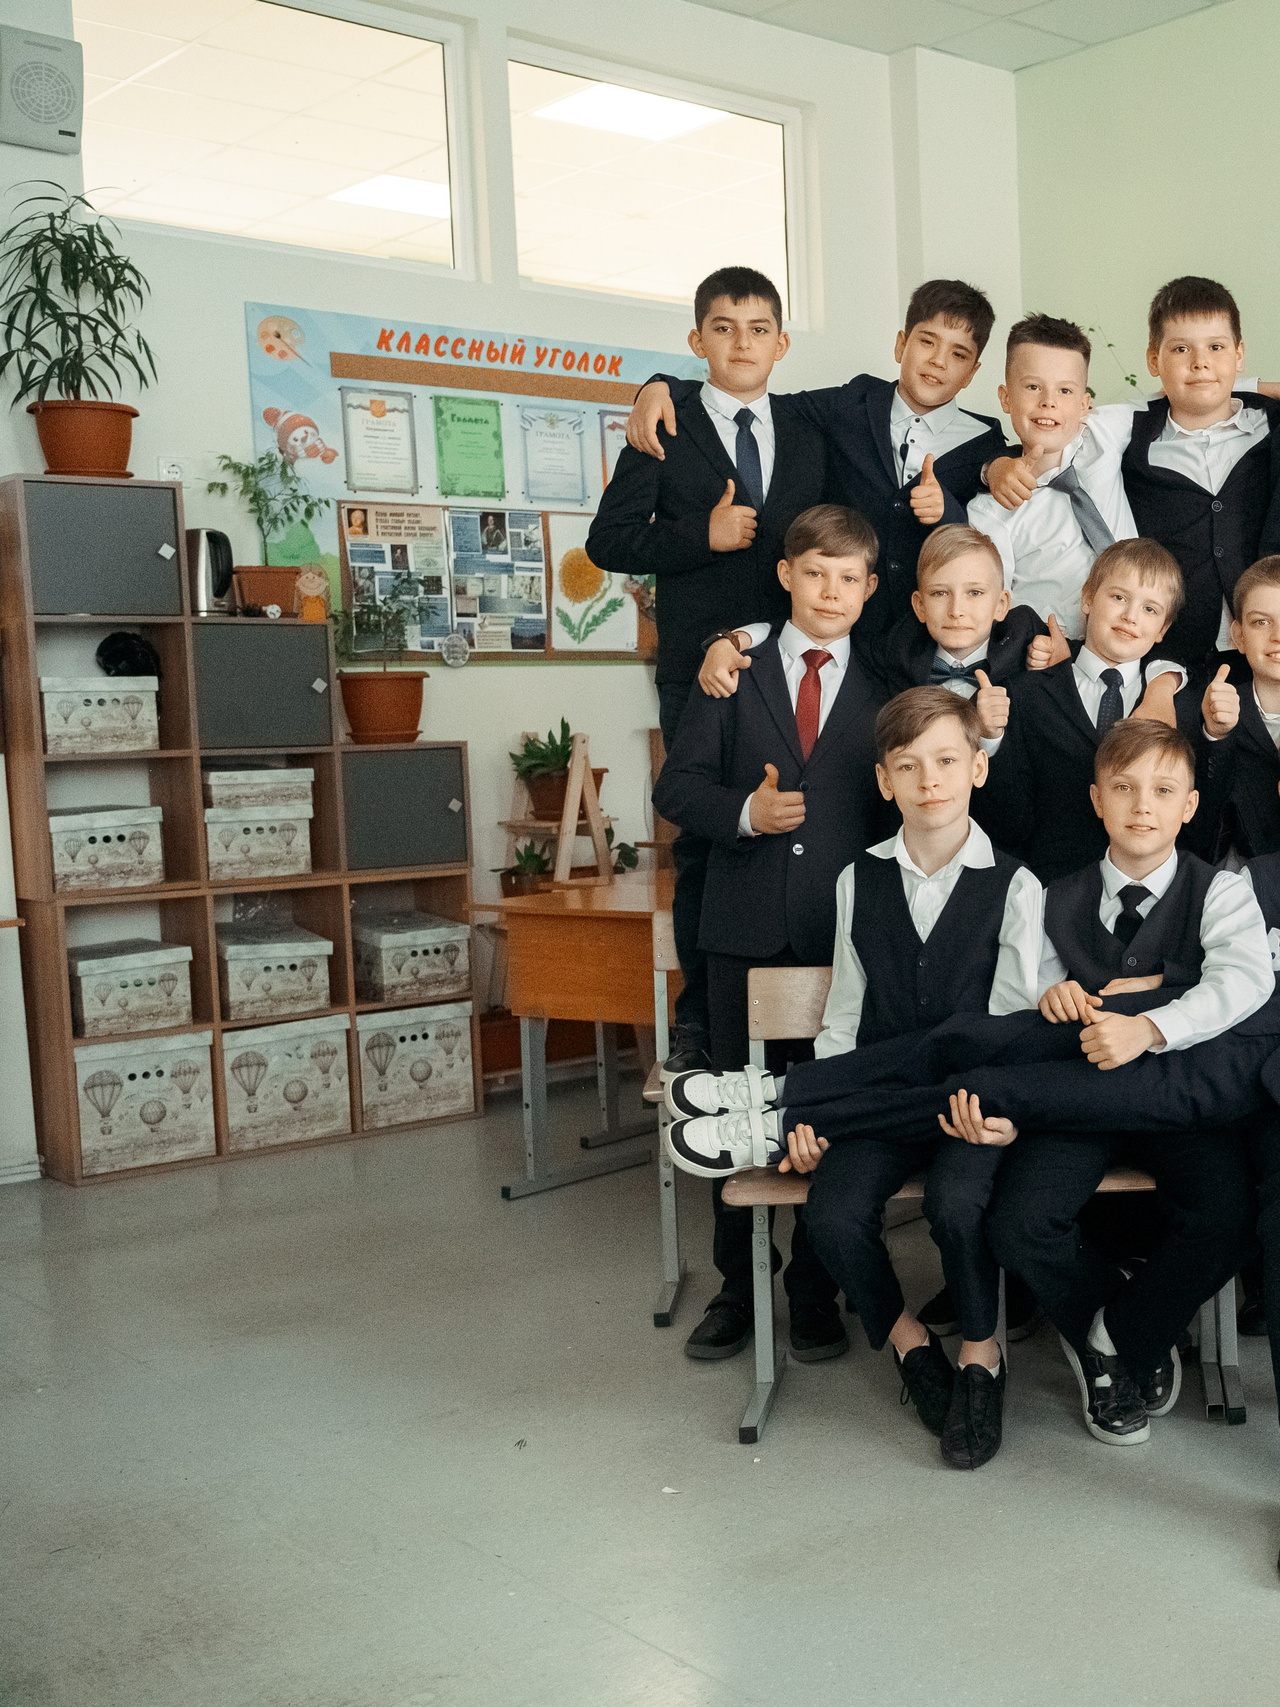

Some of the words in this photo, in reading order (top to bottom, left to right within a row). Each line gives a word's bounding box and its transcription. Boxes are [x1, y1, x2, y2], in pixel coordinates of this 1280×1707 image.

[377, 328, 526, 365] КЛАССНЫЙ
[534, 346, 623, 377] УГОЛОК
[535, 431, 571, 440] ГРАМОТА
